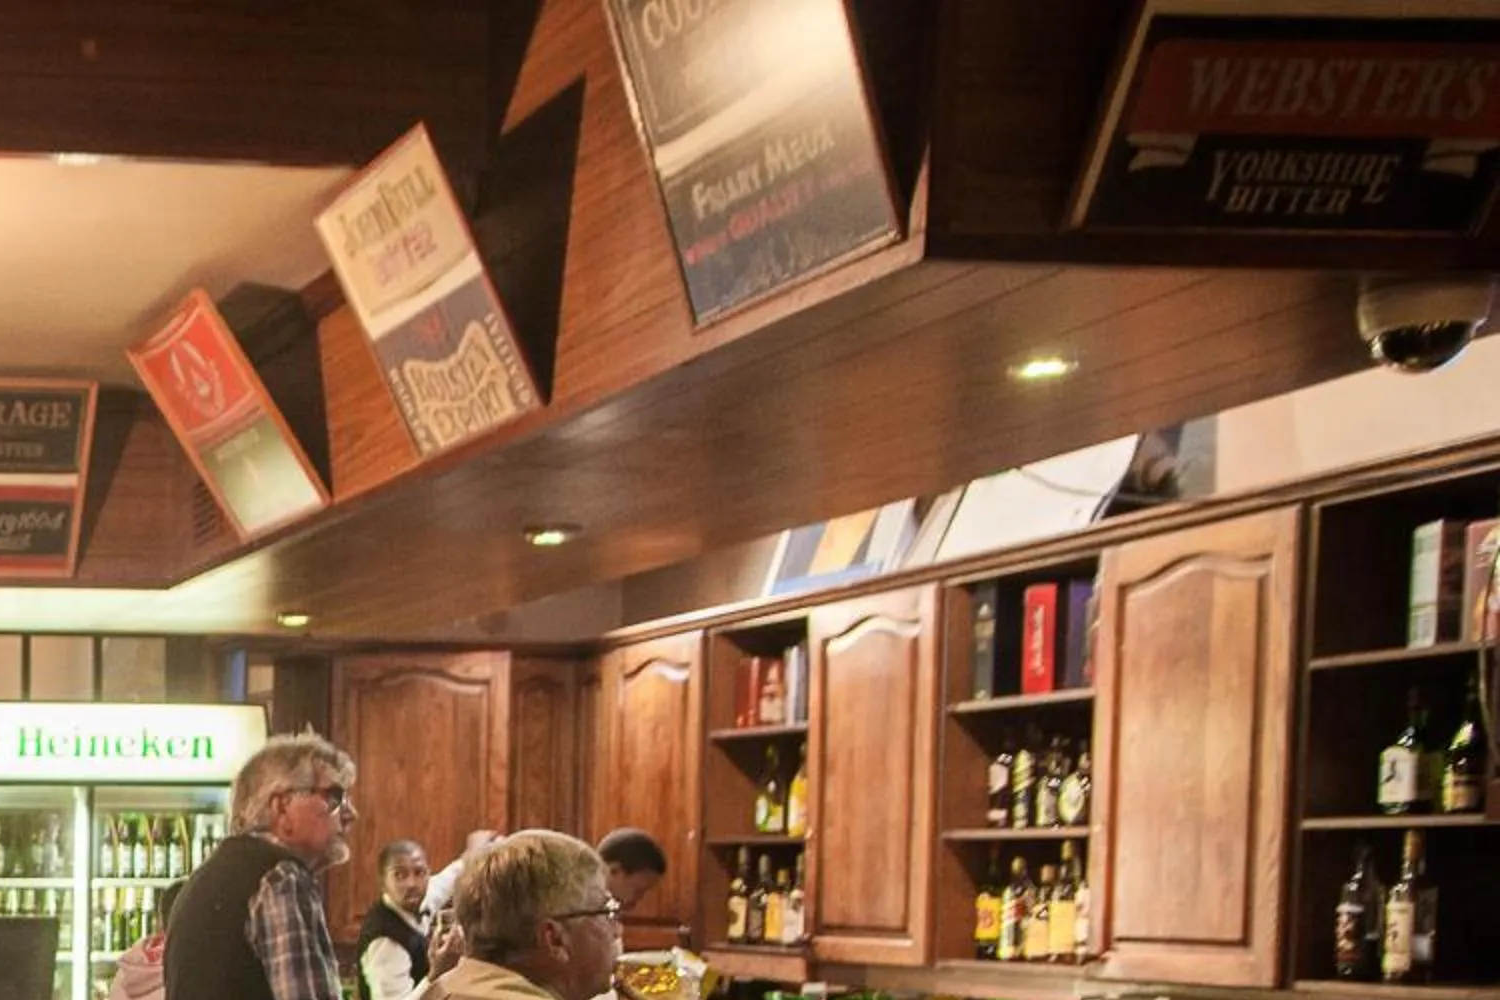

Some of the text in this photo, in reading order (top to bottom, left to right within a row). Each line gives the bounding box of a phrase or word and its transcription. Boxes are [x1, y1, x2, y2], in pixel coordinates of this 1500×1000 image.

[642, 0, 714, 49] COU
[1187, 56, 1497, 121] WEBSTER'S
[1205, 149, 1401, 205] YORKSHIRE
[1223, 185, 1353, 215] BITTER
[16, 726, 215, 760] Heineken
